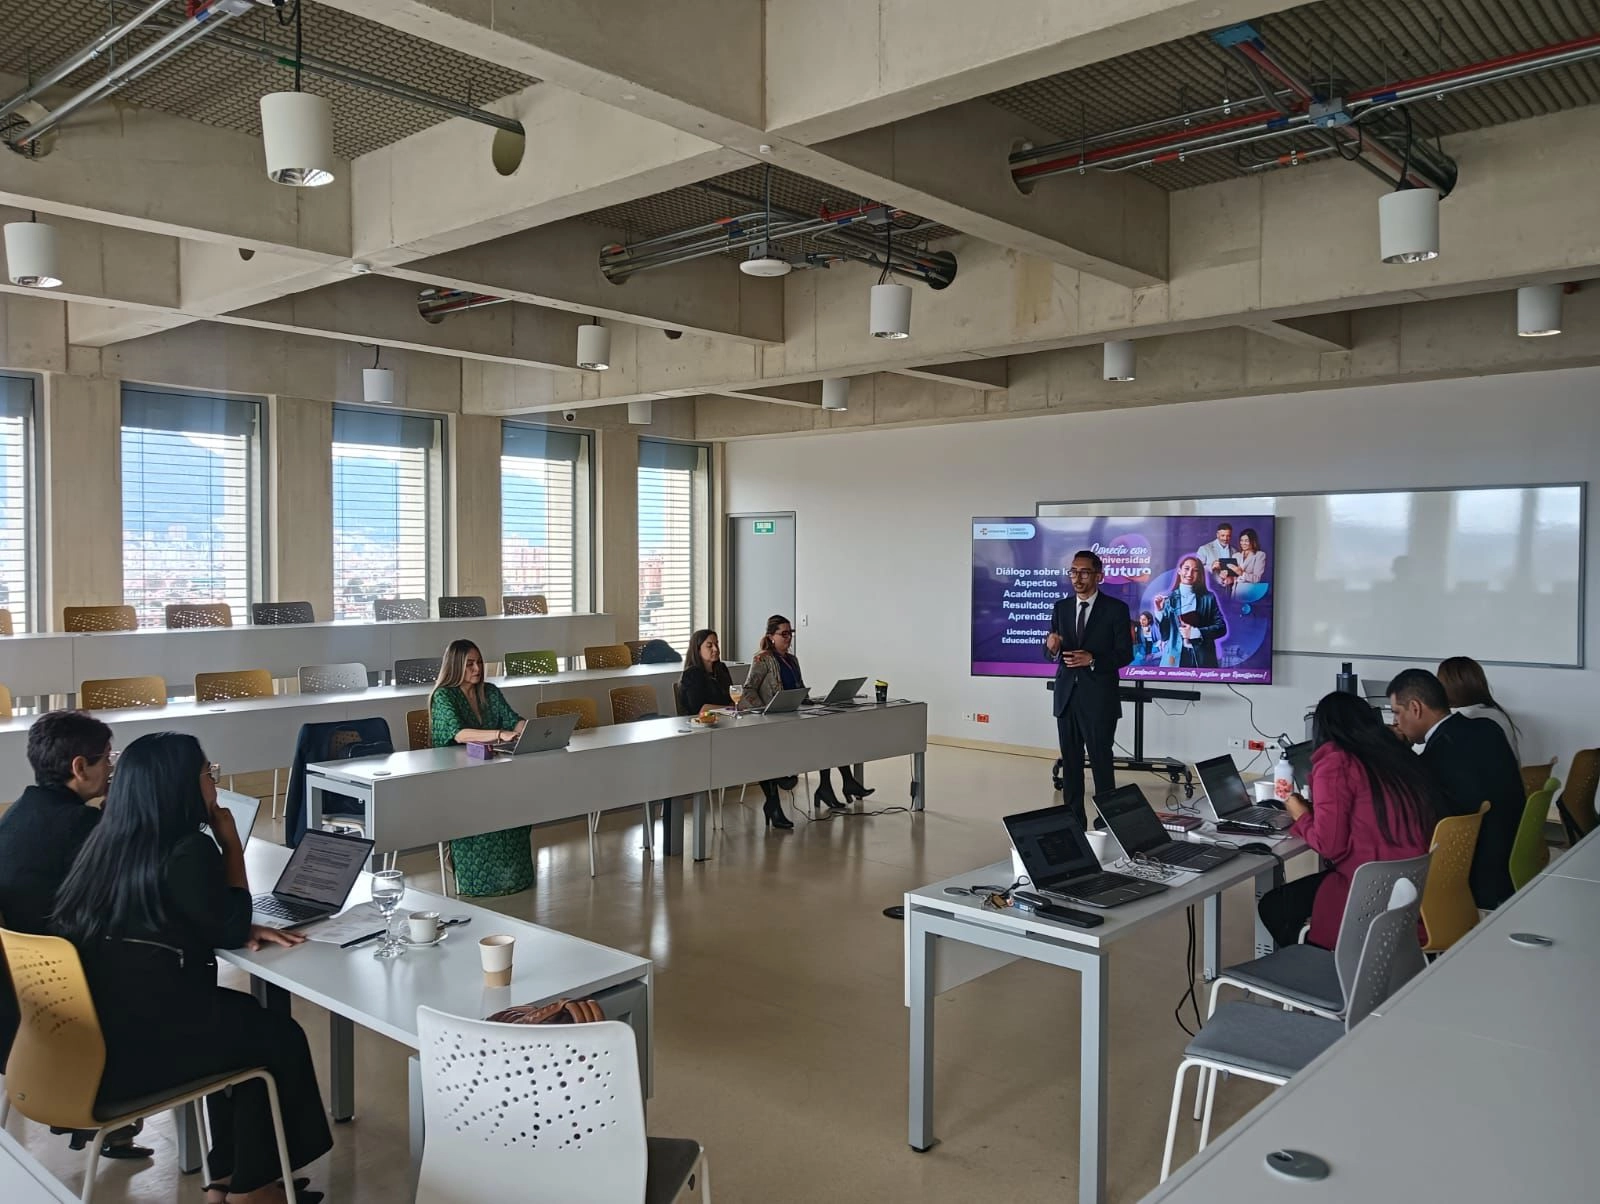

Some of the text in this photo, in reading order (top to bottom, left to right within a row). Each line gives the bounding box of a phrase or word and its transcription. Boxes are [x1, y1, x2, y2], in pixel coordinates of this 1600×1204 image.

[1090, 542, 1148, 556] Conecta con
[995, 567, 1031, 577] Diálogo
[1033, 567, 1060, 576] sobre
[1104, 564, 1152, 577] futuro
[1013, 578, 1058, 588] Aspectos
[1003, 589, 1068, 599] Académicos y
[1002, 600, 1055, 610] Resultados
